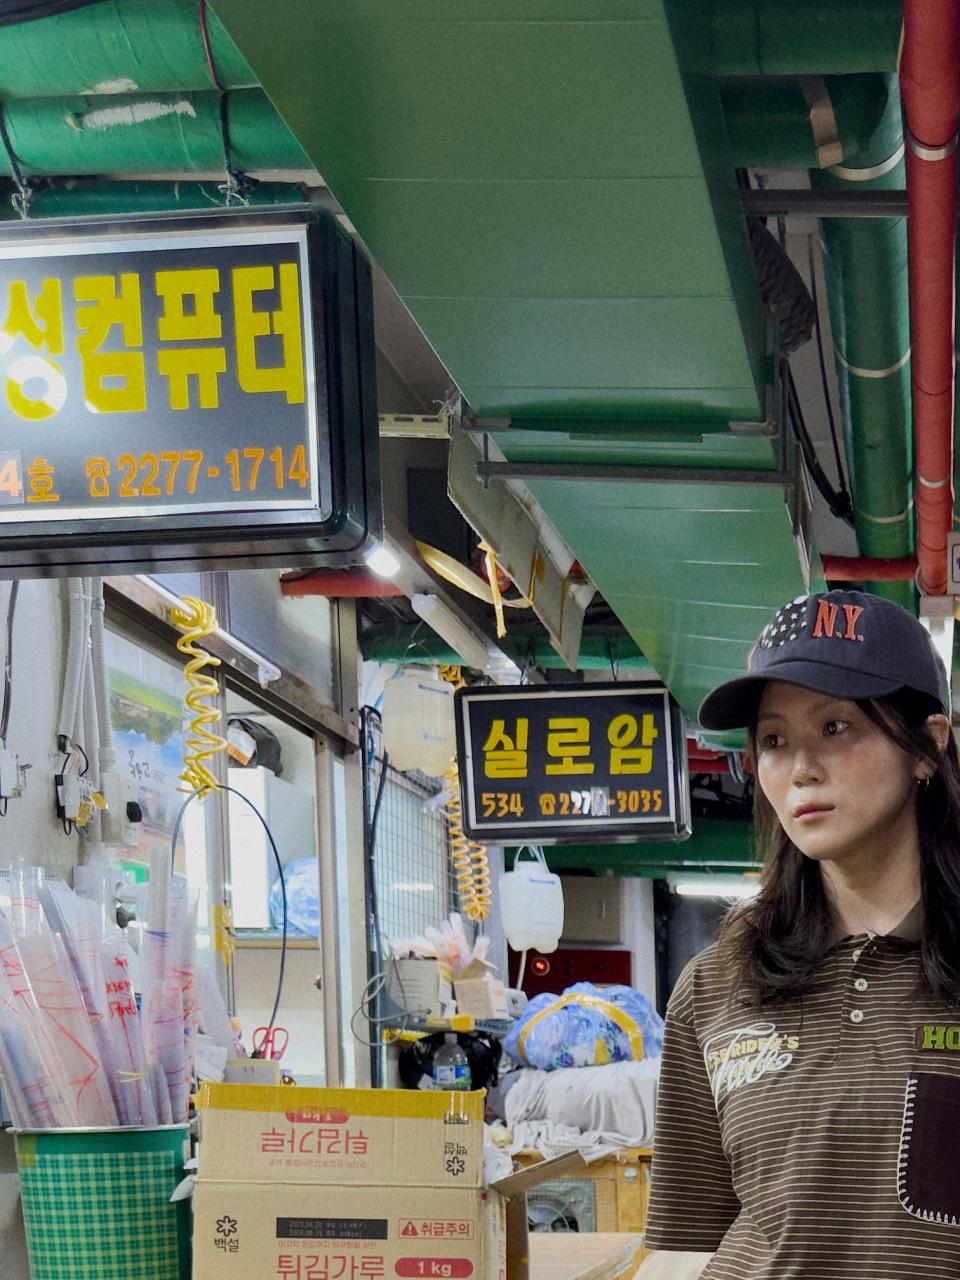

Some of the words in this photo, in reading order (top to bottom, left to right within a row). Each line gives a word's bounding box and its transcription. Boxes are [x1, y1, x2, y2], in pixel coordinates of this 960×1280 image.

[3, 263, 305, 421] 성컴퓨터
[117, 445, 309, 497] 2277-1714
[483, 714, 658, 779] 실로암
[482, 793, 524, 817] 534
[261, 1127, 369, 1155] 튀김가루
[421, 1222, 470, 1237] 취급주의
[214, 1238, 239, 1253] 백설
[277, 1255, 385, 1280] 튀김가루
[431, 1260, 452, 1276] kg
